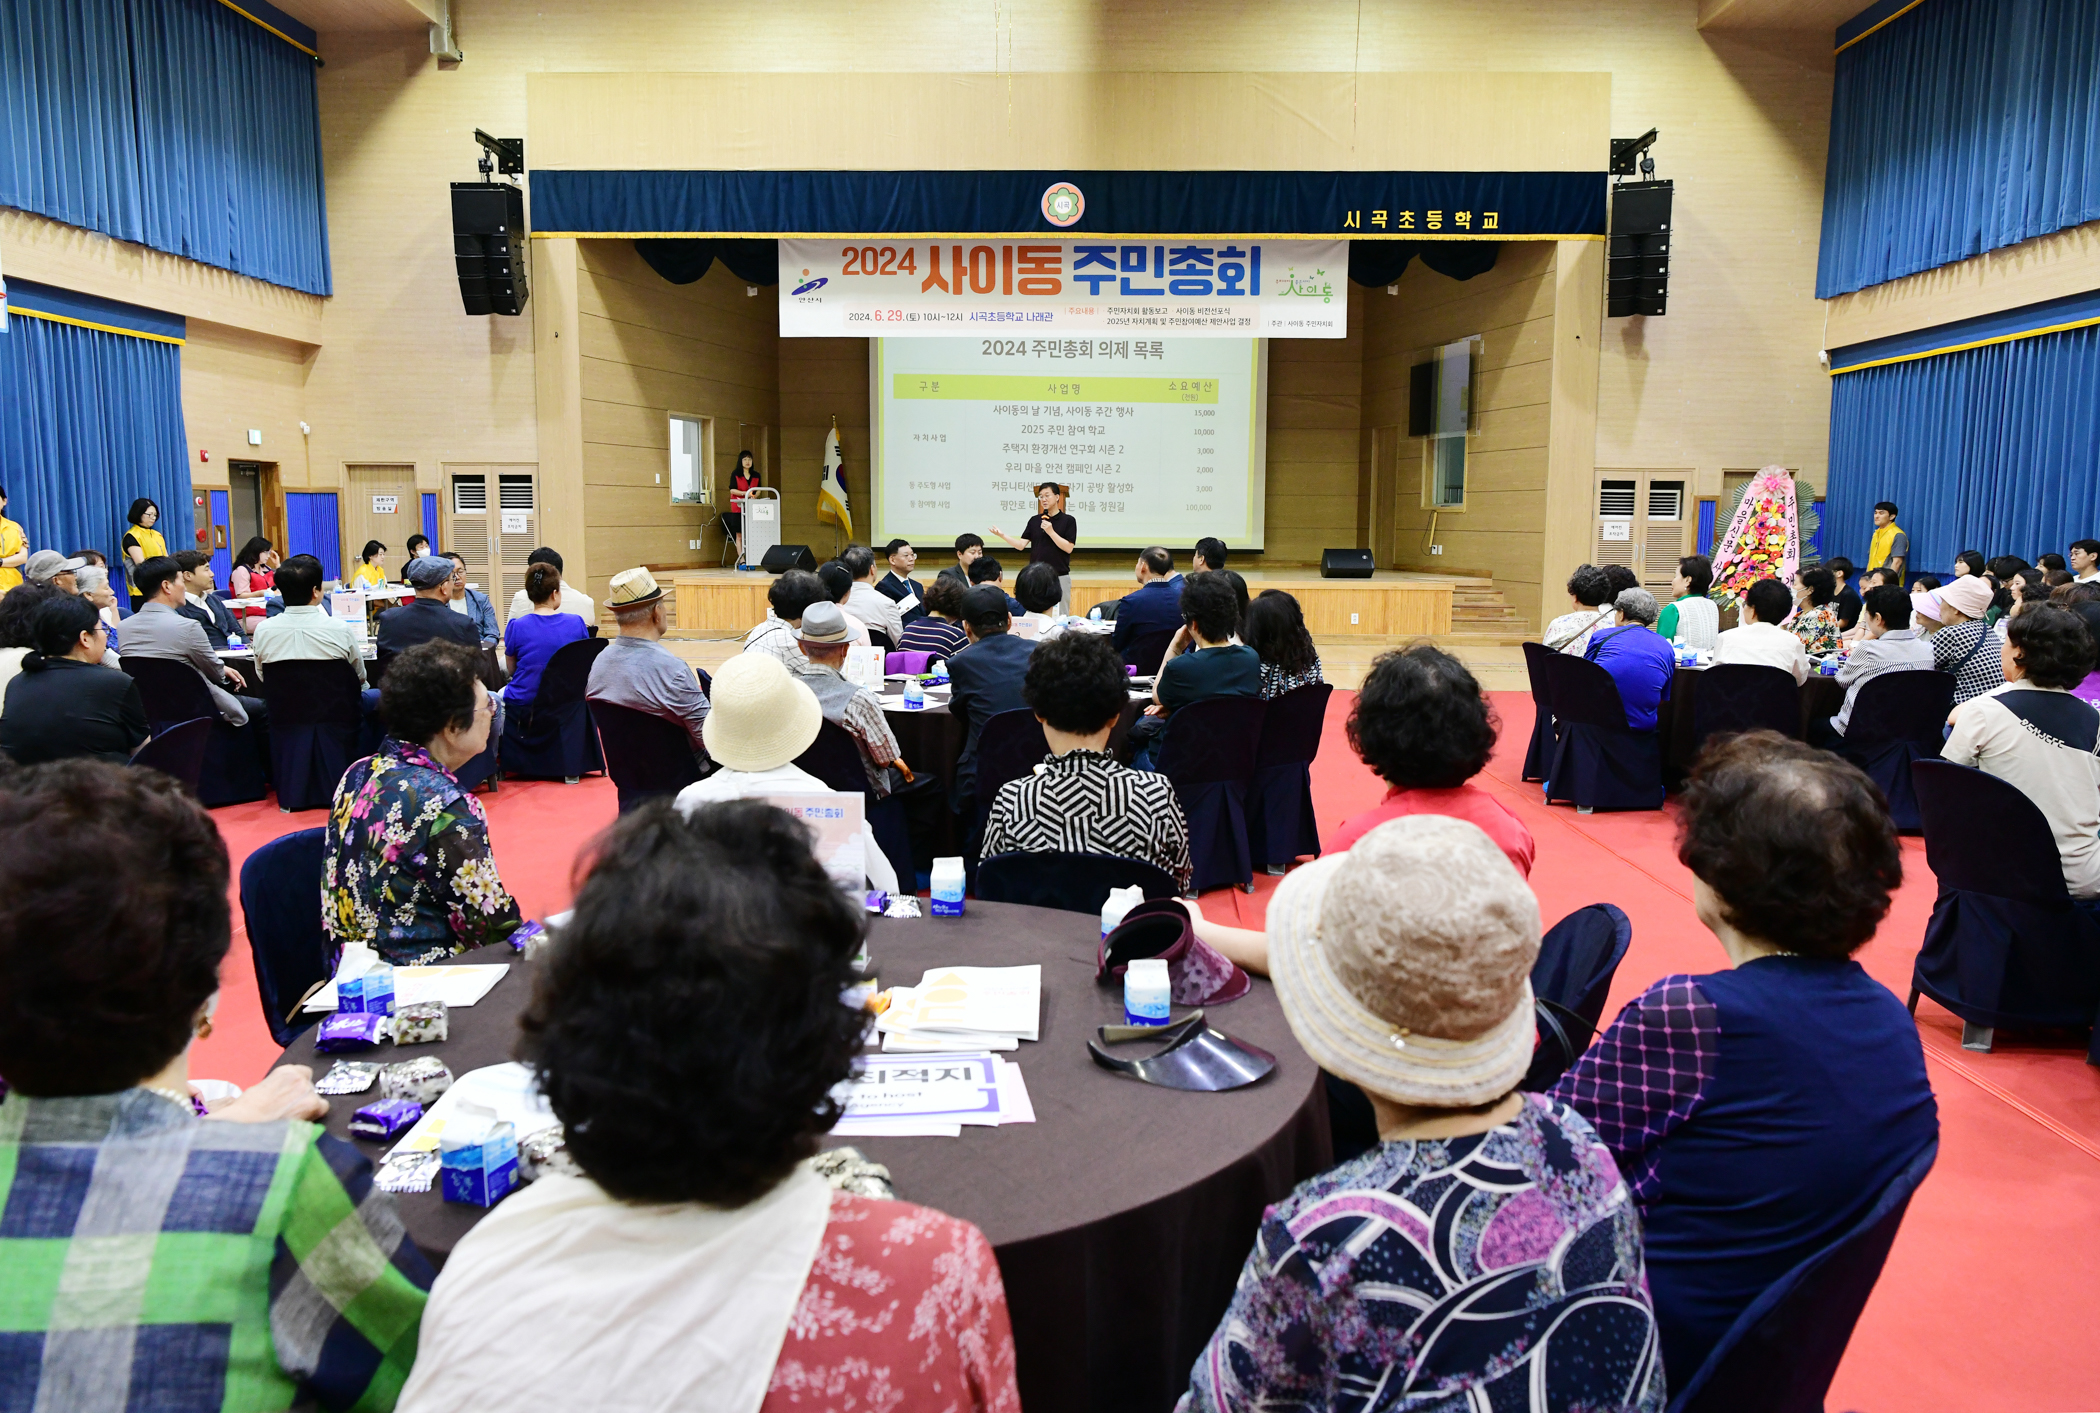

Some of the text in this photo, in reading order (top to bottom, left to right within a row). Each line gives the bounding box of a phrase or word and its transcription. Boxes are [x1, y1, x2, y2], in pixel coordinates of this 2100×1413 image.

[1343, 210, 1499, 230] 시곡초등학교
[842, 245, 1261, 296] 2024 사이동 주민총회
[848, 312, 872, 322] 2024.
[923, 313, 963, 322] 10시~12시
[969, 312, 1024, 322] 시곡초등학교
[1026, 312, 1054, 322] 나래관
[1106, 306, 1140, 316] 주민자치회
[1142, 306, 1168, 316] 활동보고
[1176, 306, 1196, 316] 사이동
[1197, 307, 1231, 316] 비전선포식
[1106, 318, 1130, 326] 2025년
[1132, 318, 1158, 326] 자치계획
[1160, 318, 1167, 326] 및
[1168, 318, 1208, 326] 주민참여예산
[1210, 318, 1236, 326] 제안사업
[1288, 320, 1304, 328] 사이동
[982, 340, 1164, 360] 2024 주민총회 의제 목록
[993, 405, 1028, 416] 사이동의
[1032, 406, 1040, 416] 날
[1043, 406, 1064, 417] 기념,
[1066, 406, 1092, 418] 사이동
[1095, 406, 1112, 417] 주간
[1116, 406, 1134, 417] 행사
[1021, 424, 1215, 436] 2025 주민 참여 학교 10,000
[1002, 443, 1214, 456] 주택지 환경개선 연구회 시즌 2 3,000
[1004, 462, 1214, 474] 우리 마을 안전 캠페인 시즌 2 2,000
[991, 481, 1036, 492] 커뮤니티센
[1087, 482, 1104, 493] 공방
[1107, 482, 1134, 494] 활성화
[1196, 485, 1212, 493] 3,000
[1000, 500, 1026, 512] 평안로
[1028, 500, 1038, 510] 테
[1064, 501, 1076, 512] 는
[1078, 501, 1096, 512] 마을
[1099, 501, 1125, 512] 정원길
[1724, 496, 1754, 552] 마을신문
[1786, 496, 1797, 561] 주민총회
[806, 807, 844, 818] 주민총회
